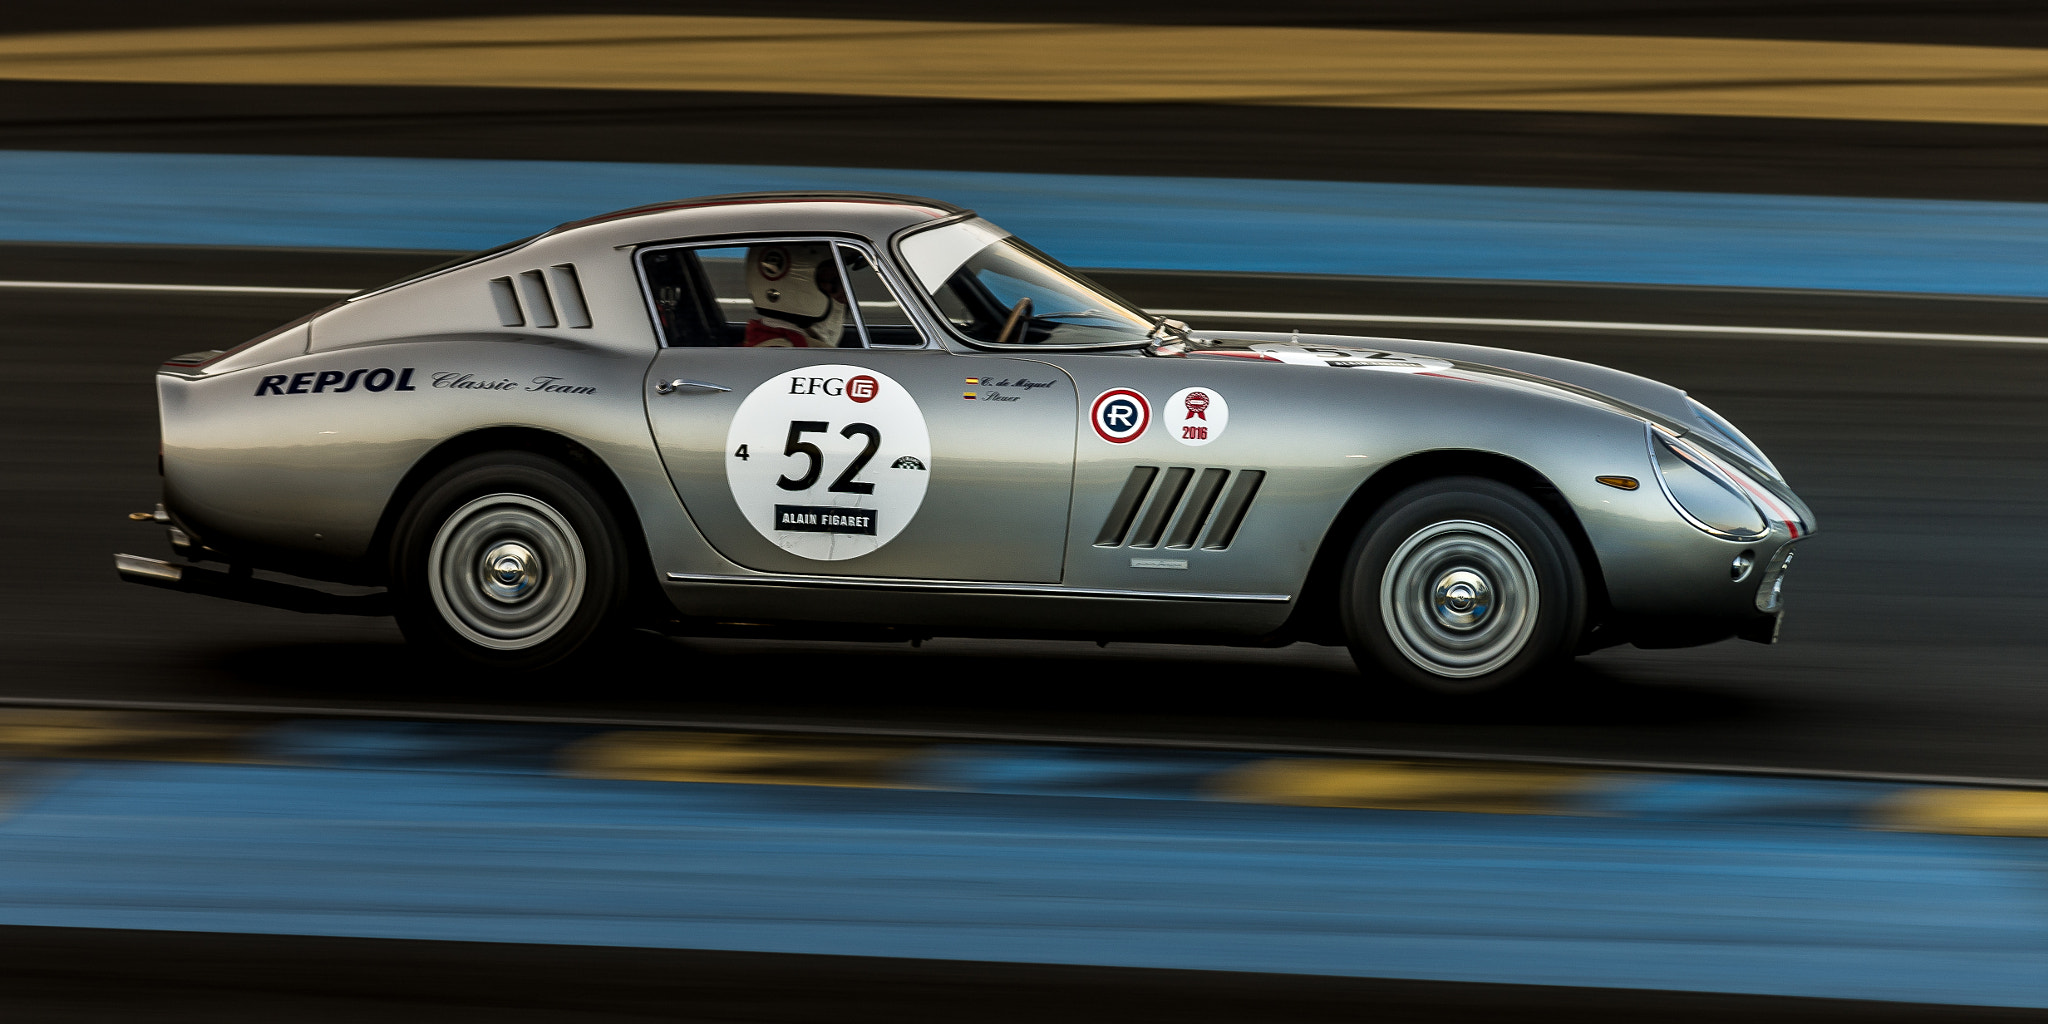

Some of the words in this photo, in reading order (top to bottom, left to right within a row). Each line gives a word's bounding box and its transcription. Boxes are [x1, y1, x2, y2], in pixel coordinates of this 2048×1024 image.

[254, 367, 416, 396] REPSOL
[431, 371, 518, 391] Classic
[525, 375, 597, 395] Team
[788, 376, 844, 396] EFG
[996, 378, 1010, 387] de
[1011, 378, 1058, 391] Miguel
[1182, 426, 1209, 440] 2016
[734, 443, 750, 461] 4
[776, 420, 882, 495] 52
[781, 512, 818, 526] ALAIN
[820, 513, 870, 528] FIGARET
